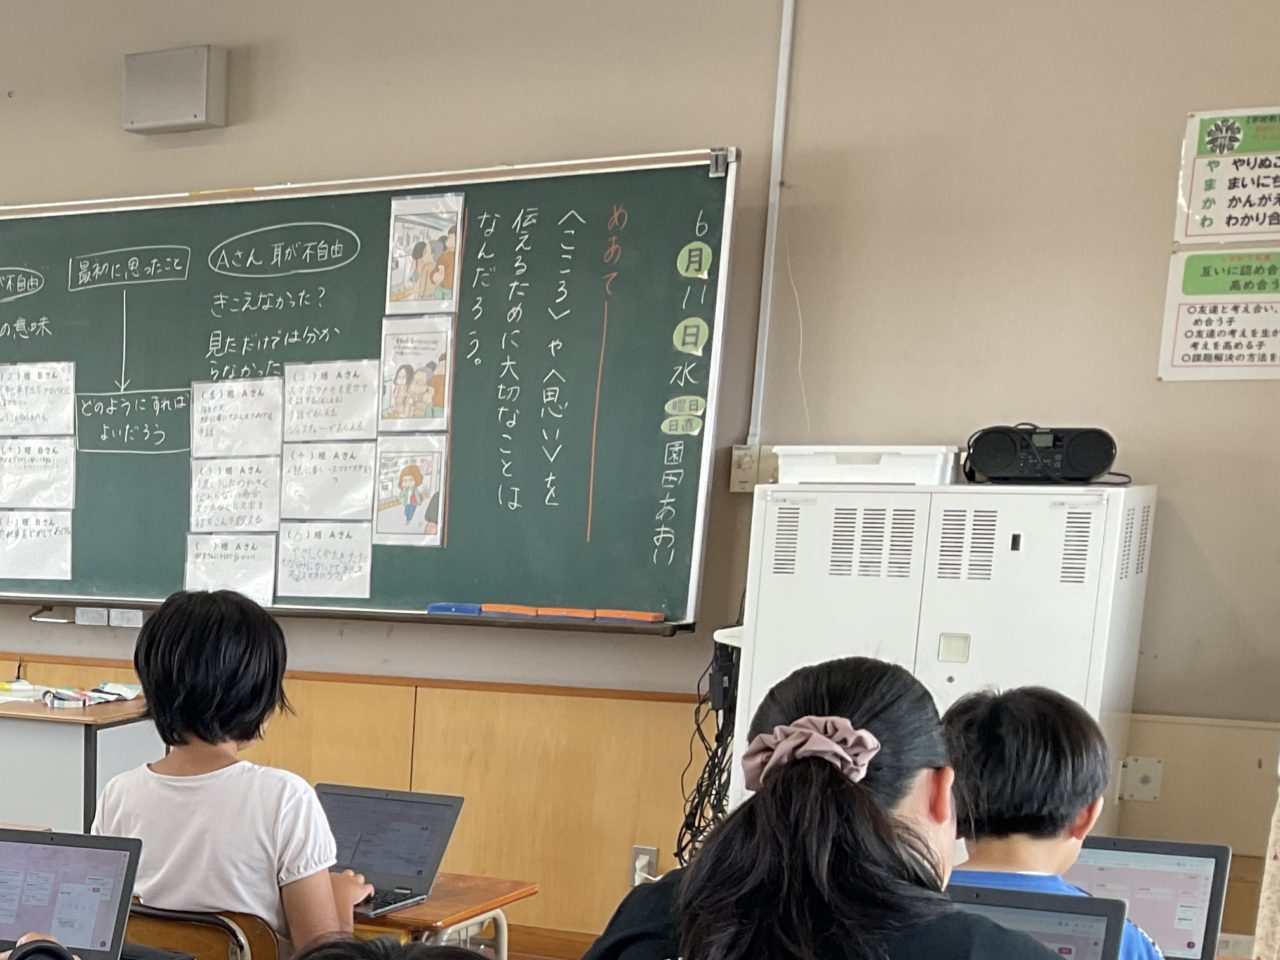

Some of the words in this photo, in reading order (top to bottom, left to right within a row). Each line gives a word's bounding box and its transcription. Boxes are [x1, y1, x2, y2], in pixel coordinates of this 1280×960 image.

[1206, 160, 1220, 172] や
[1204, 178, 1216, 191] ま
[1201, 197, 1216, 210] か
[1200, 215, 1214, 228] わ
[603, 204, 627, 297] めあて
[77, 255, 184, 285] 最初に思ったこと
[1190, 340, 1266, 351] 考えを高める子
[497, 208, 538, 510] 伝えるために大切なことは
[80, 394, 190, 418] どのようにすれば
[100, 422, 166, 446] よいだろう
